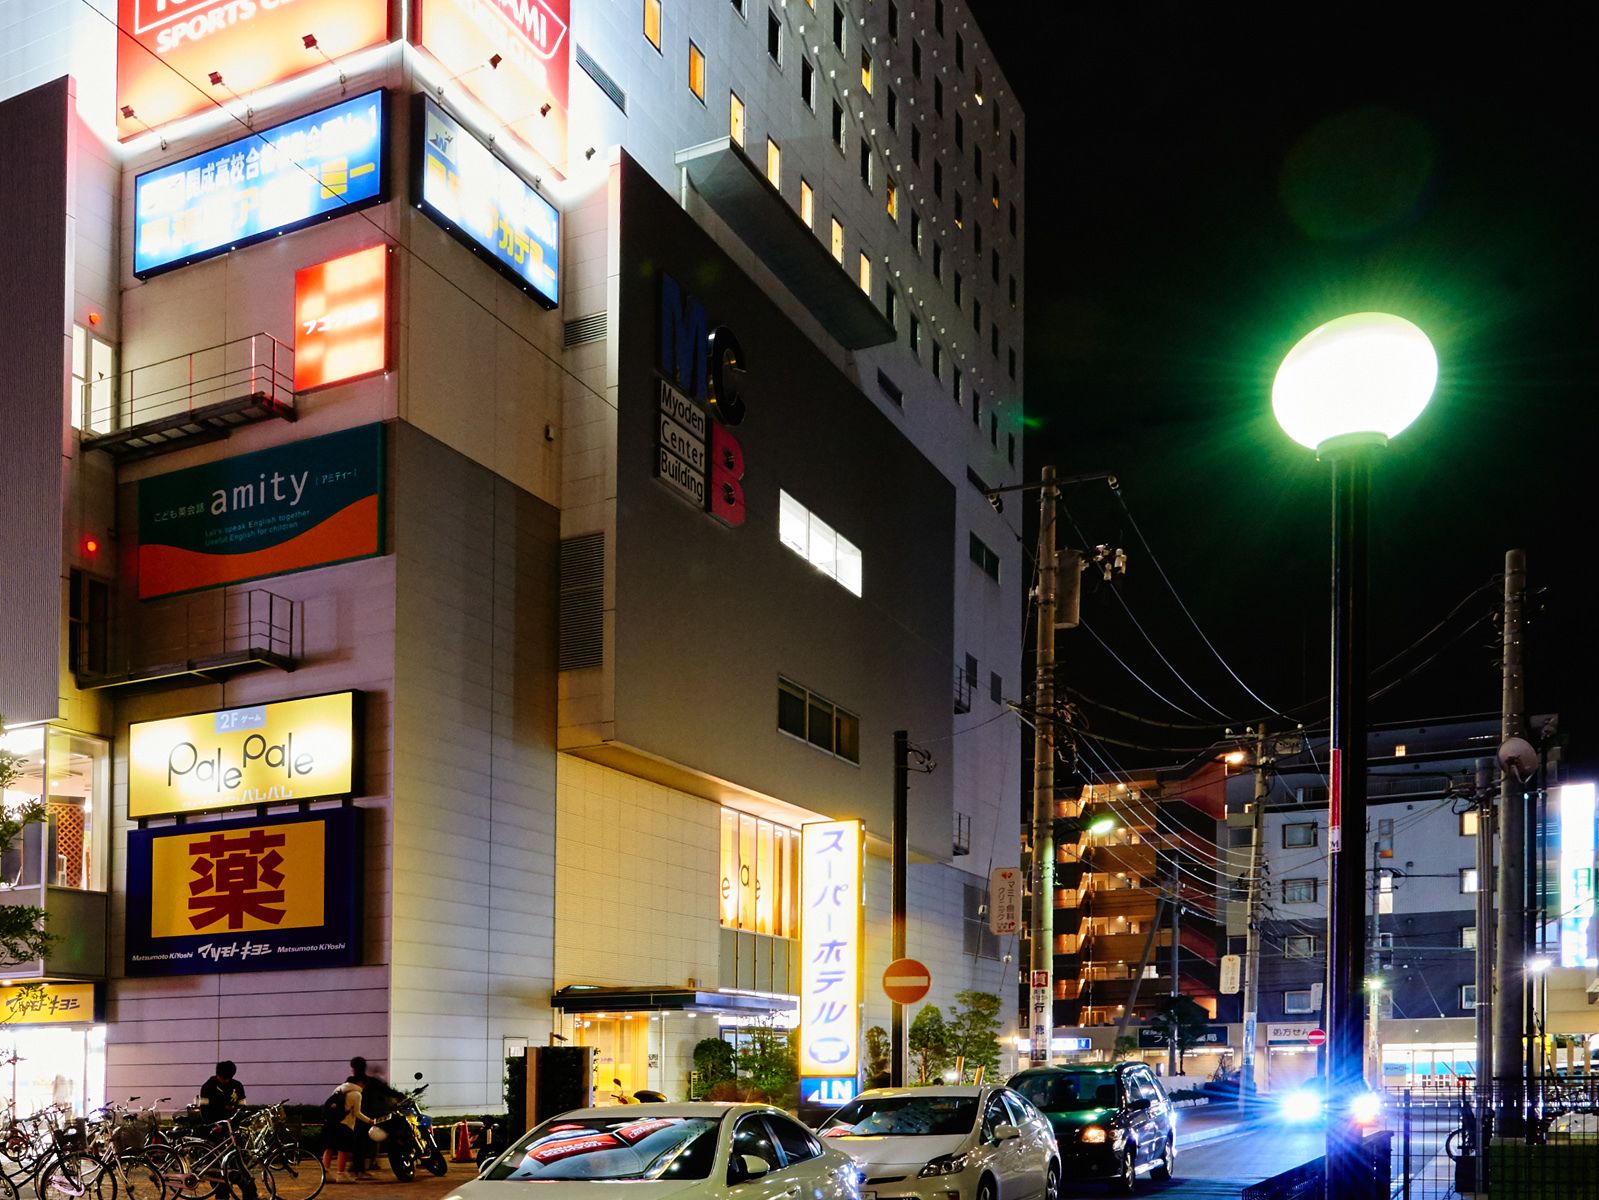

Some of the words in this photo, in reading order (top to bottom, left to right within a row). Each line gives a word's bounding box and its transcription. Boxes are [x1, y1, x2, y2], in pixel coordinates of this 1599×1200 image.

[661, 382, 704, 435] Myoden
[661, 420, 704, 467] Center
[210, 470, 309, 516] amity
[660, 449, 704, 503] Building
[229, 529, 256, 542] English
[257, 527, 268, 536] for
[248, 515, 277, 528] English
[278, 509, 310, 522] together
[220, 712, 239, 730] 2F
[240, 713, 262, 724] ゲーム
[168, 741, 242, 793] Pale
[243, 732, 314, 779] Pale
[188, 829, 288, 931] 薬
[811, 829, 849, 1025] スーパーホテル
[131, 953, 169, 962] Matsumoto
[169, 950, 194, 960] KiYoshi
[277, 944, 318, 954] Matsumoto
[318, 942, 346, 952] KiYoshi
[820, 1078, 854, 1100] IN
